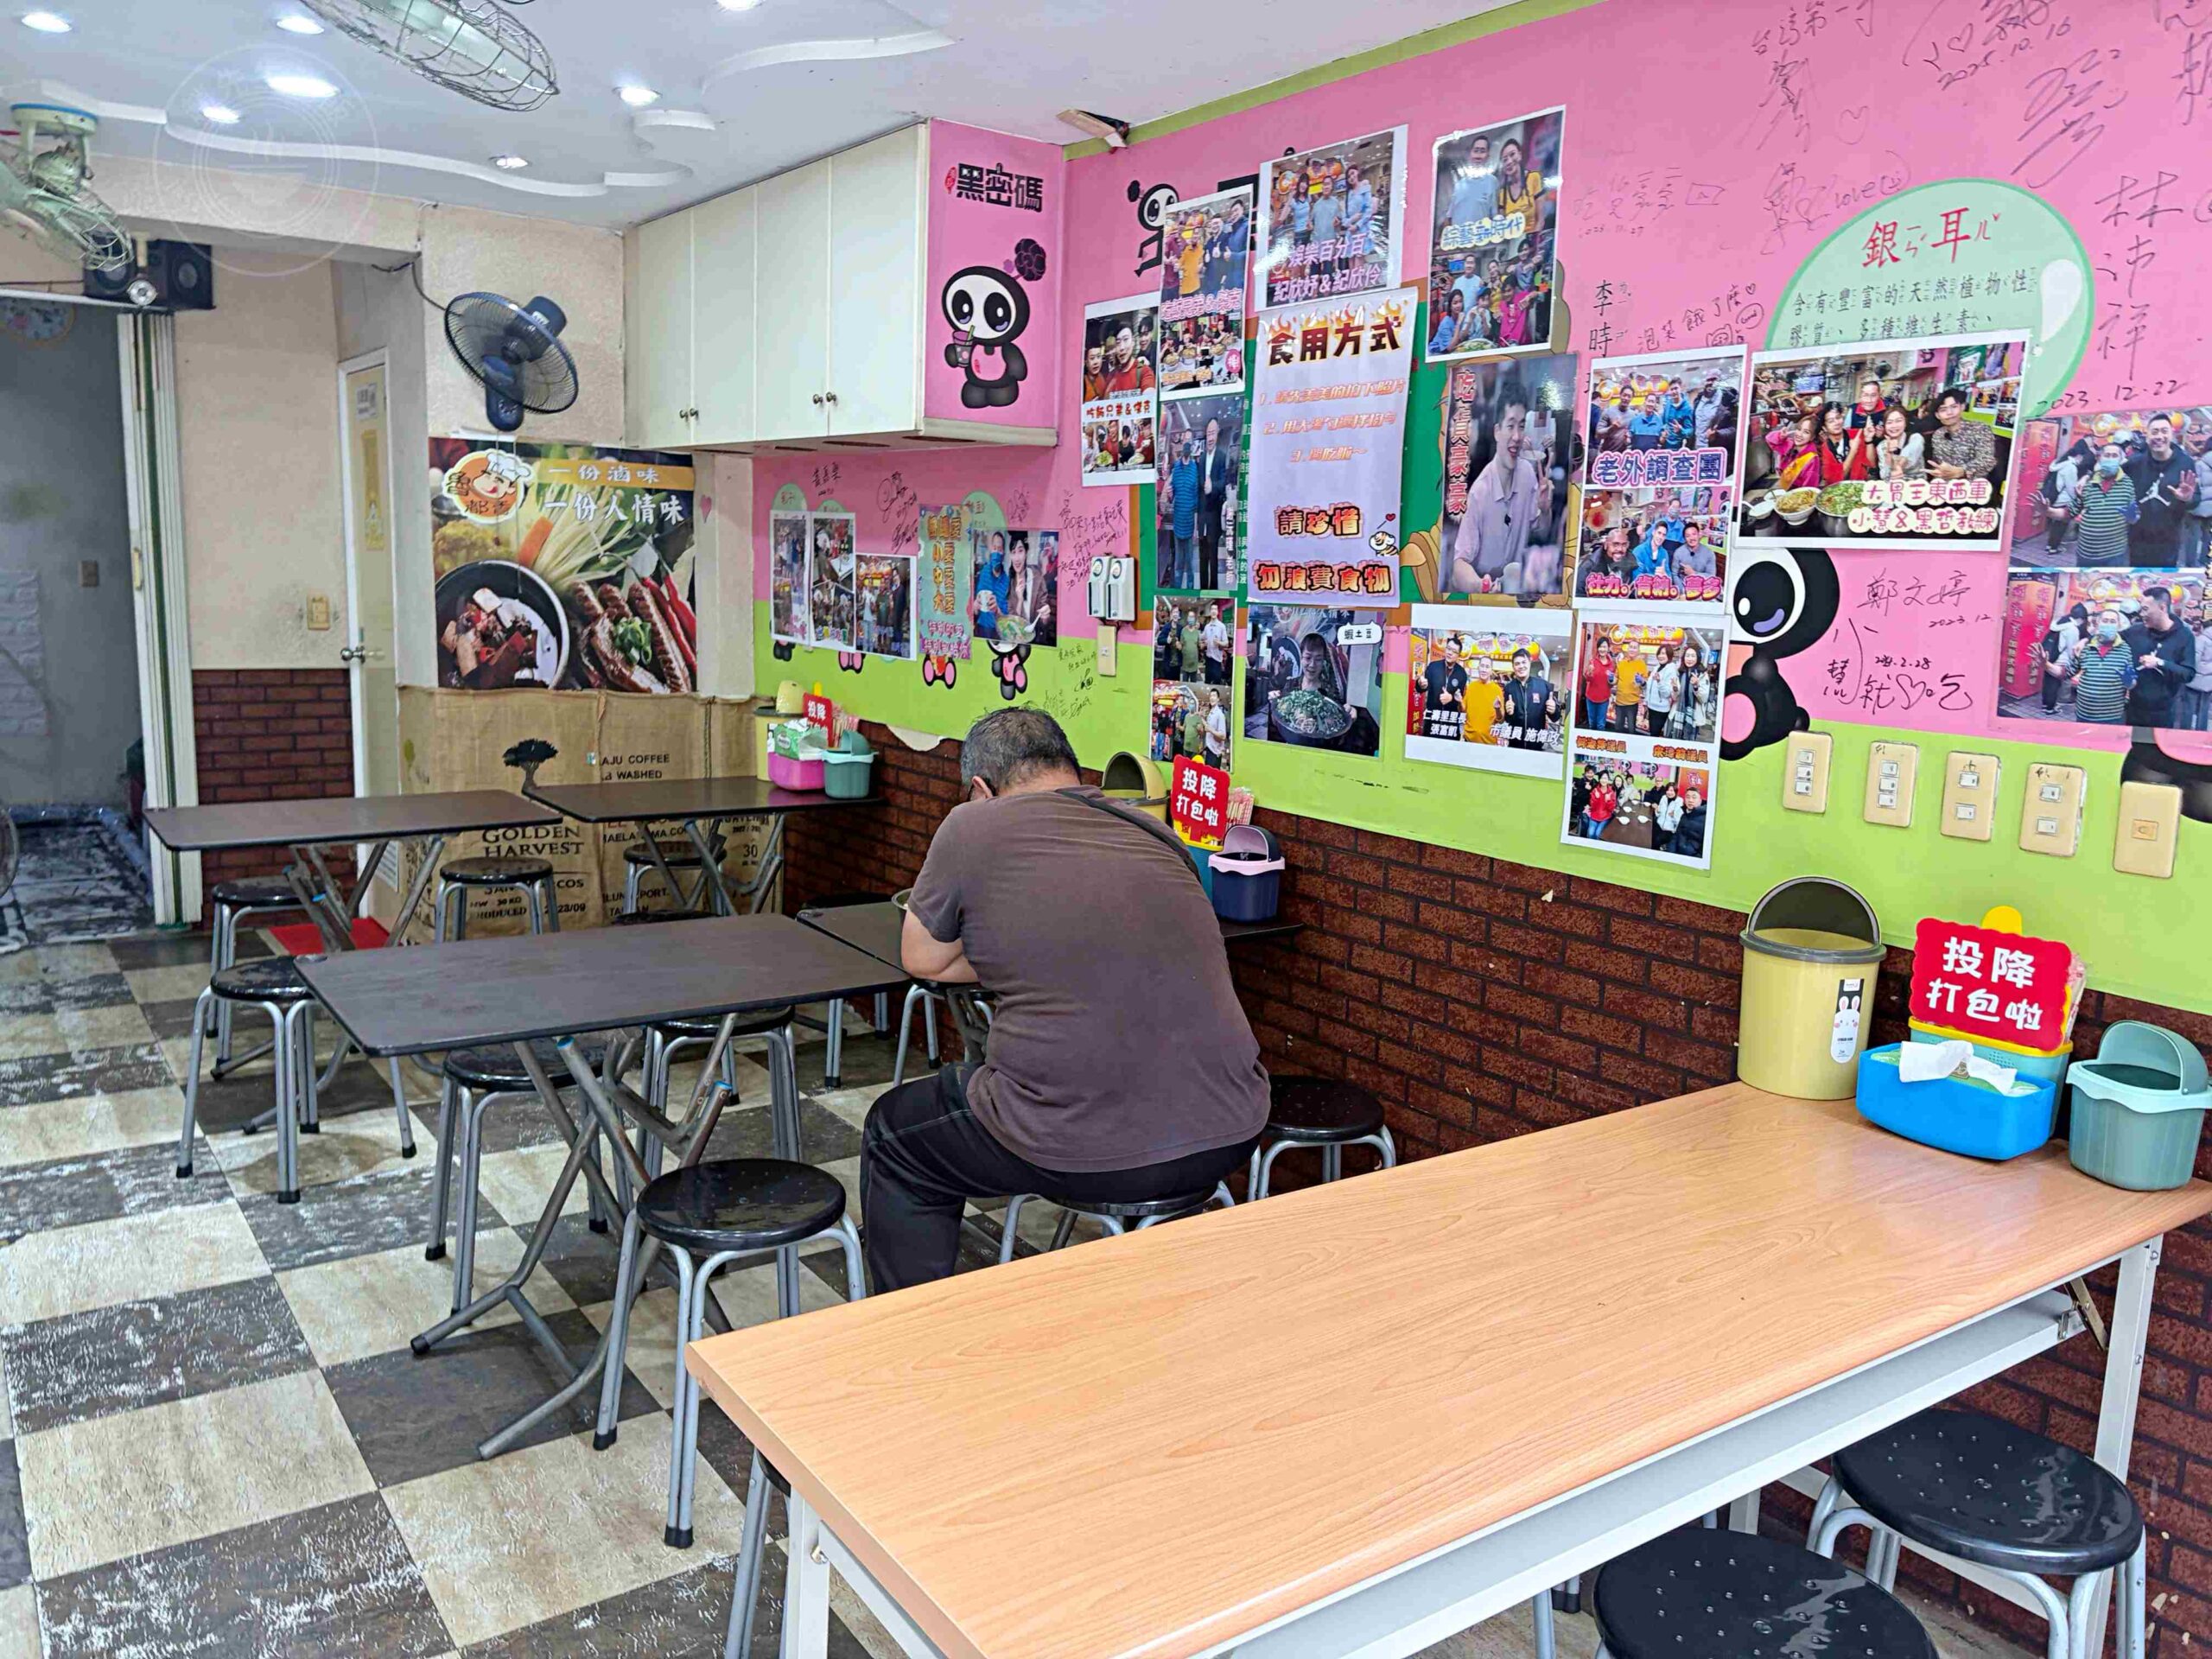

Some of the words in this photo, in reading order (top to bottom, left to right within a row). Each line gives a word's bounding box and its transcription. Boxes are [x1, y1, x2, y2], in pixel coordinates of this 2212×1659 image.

[956, 162, 1044, 213] 黑密碼
[1267, 315, 1402, 366] 食用方式
[548, 463, 659, 483] 一份滷味
[1596, 452, 1723, 485] 老外調查團
[544, 491, 687, 524] 一份人情味
[1867, 480, 1989, 503] 大胃王東西軍
[1277, 504, 1363, 538] 請珍惜
[1852, 508, 1995, 531] 小慧&黑哲教練
[1255, 562, 1394, 596] 勿浪費食物
[616, 769, 663, 779] WASHED
[628, 753, 671, 764] COFFEE
[1182, 766, 1217, 801] 投降
[1176, 793, 1218, 828] 打包啦
[482, 826, 581, 844] GOLDEN
[485, 842, 585, 858] HARVEST
[743, 843, 758, 858] 30
[1942, 935, 2037, 989] 投降
[1926, 978, 2044, 1032] 打包啦
